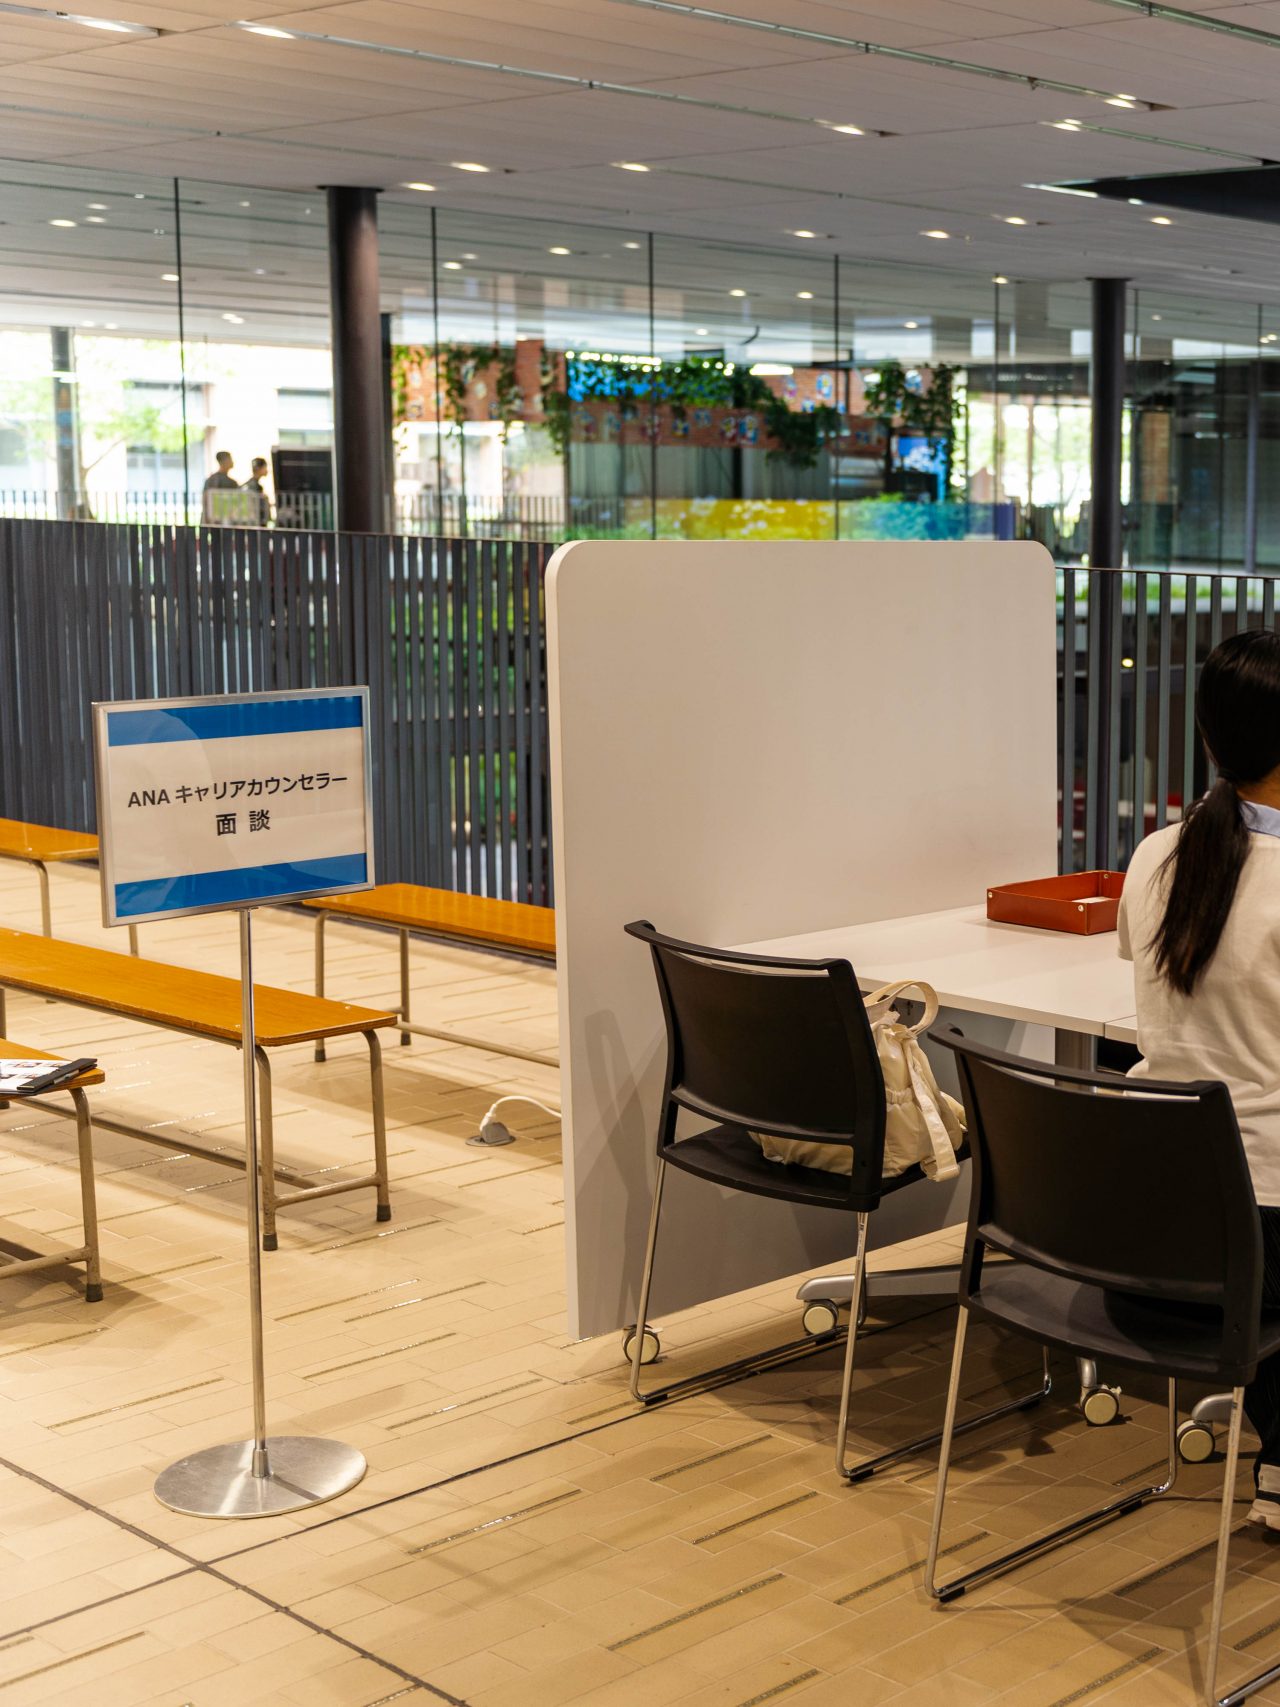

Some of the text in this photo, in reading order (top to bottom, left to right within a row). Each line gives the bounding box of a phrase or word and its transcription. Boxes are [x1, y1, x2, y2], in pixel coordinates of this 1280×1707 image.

[127, 772, 348, 808] ANA キャリアカウンセラー
[215, 809, 271, 836] 面談
